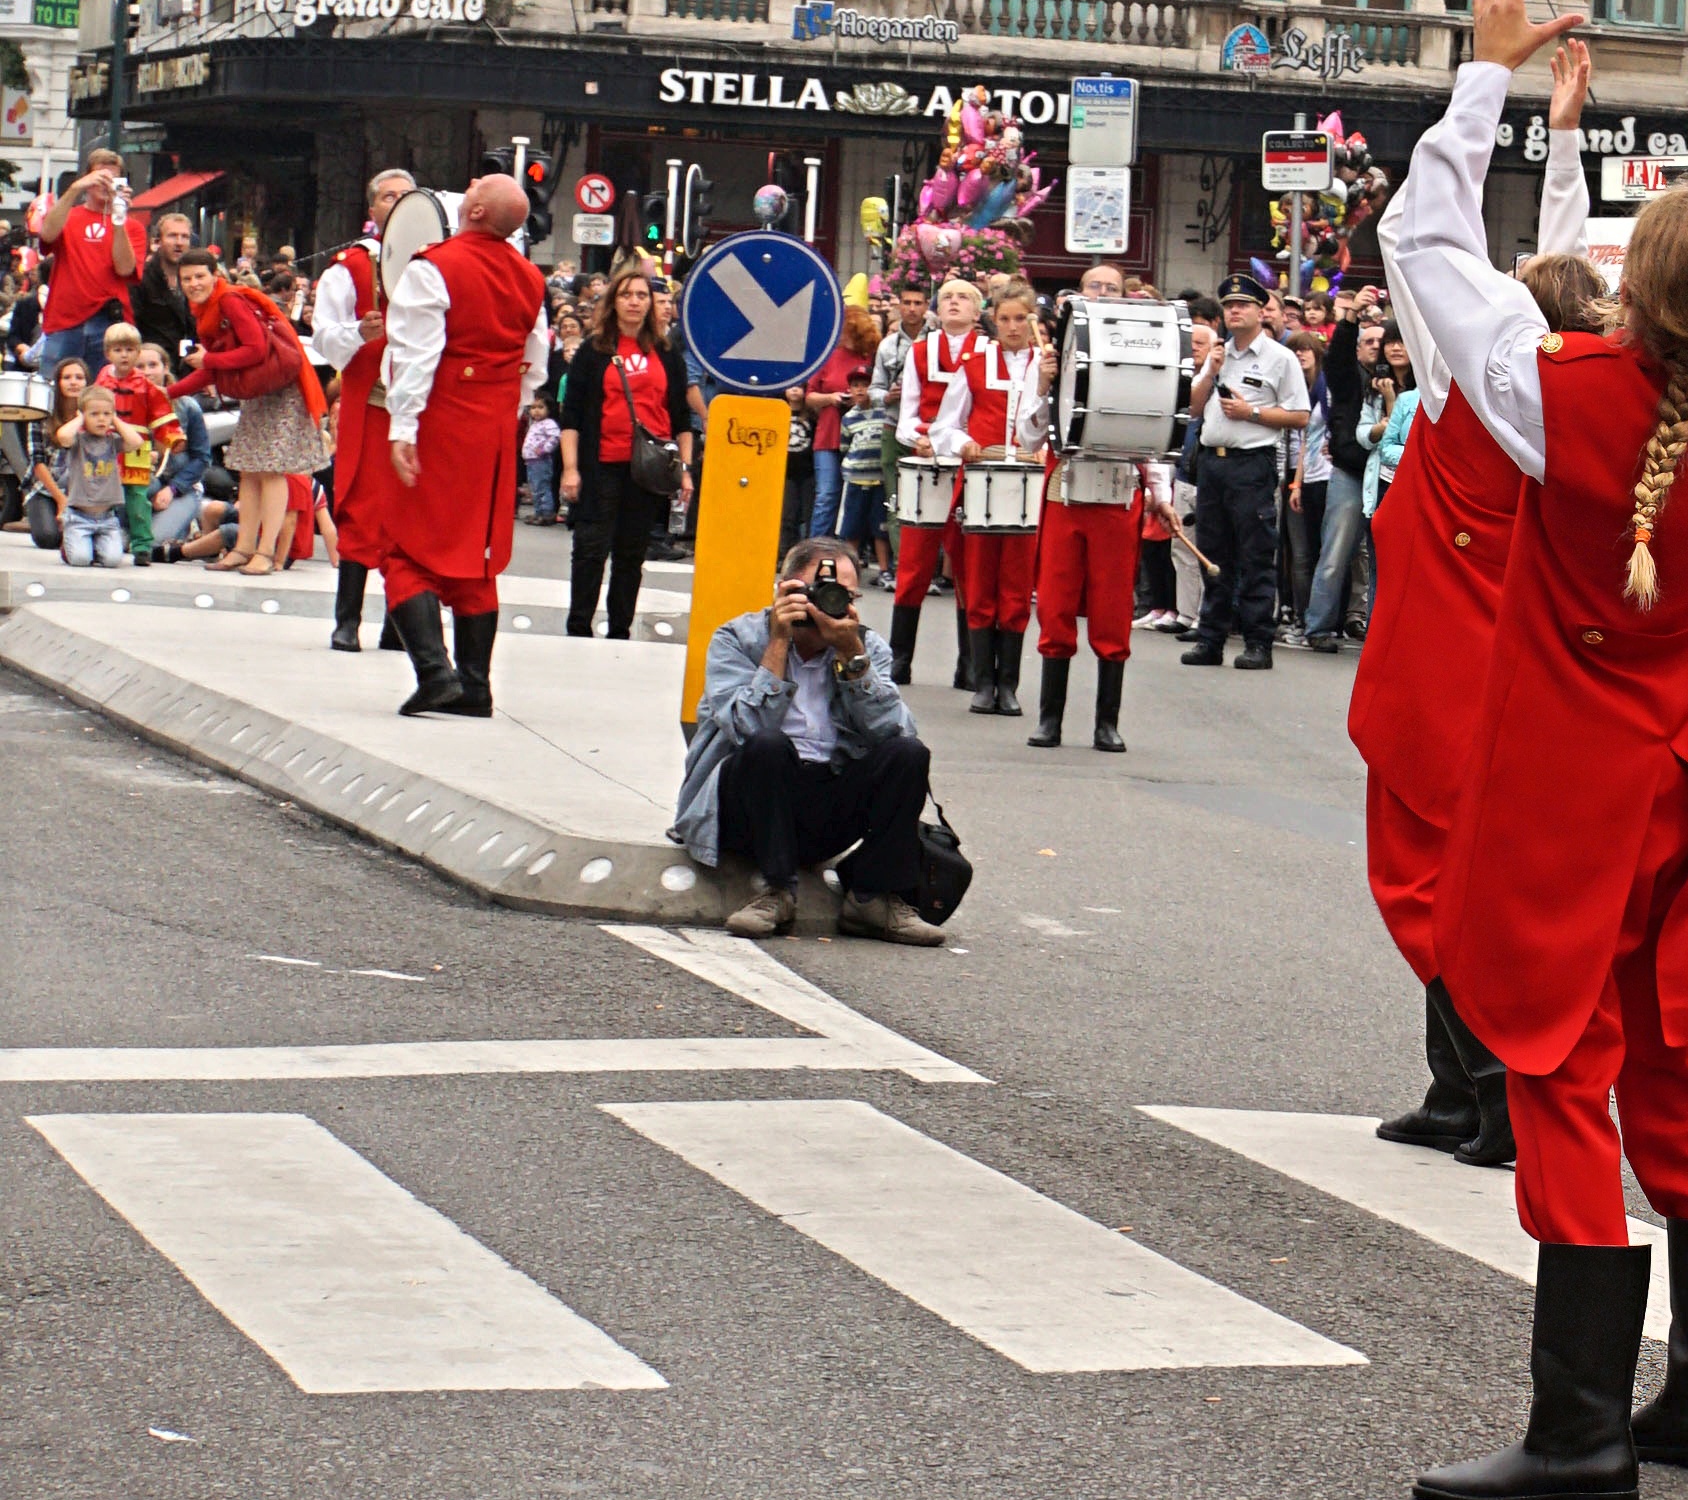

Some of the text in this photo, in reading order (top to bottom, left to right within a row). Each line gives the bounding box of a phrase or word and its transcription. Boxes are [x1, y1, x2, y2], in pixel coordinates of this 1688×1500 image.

[36, 5, 54, 25] TO
[840, 10, 958, 43] Hoegaarden
[1272, 27, 1365, 78] Leffe
[659, 68, 1070, 125] STELLA ATOI
[1268, 140, 1315, 149] COLLECTO
[1524, 115, 1637, 162] gnd
